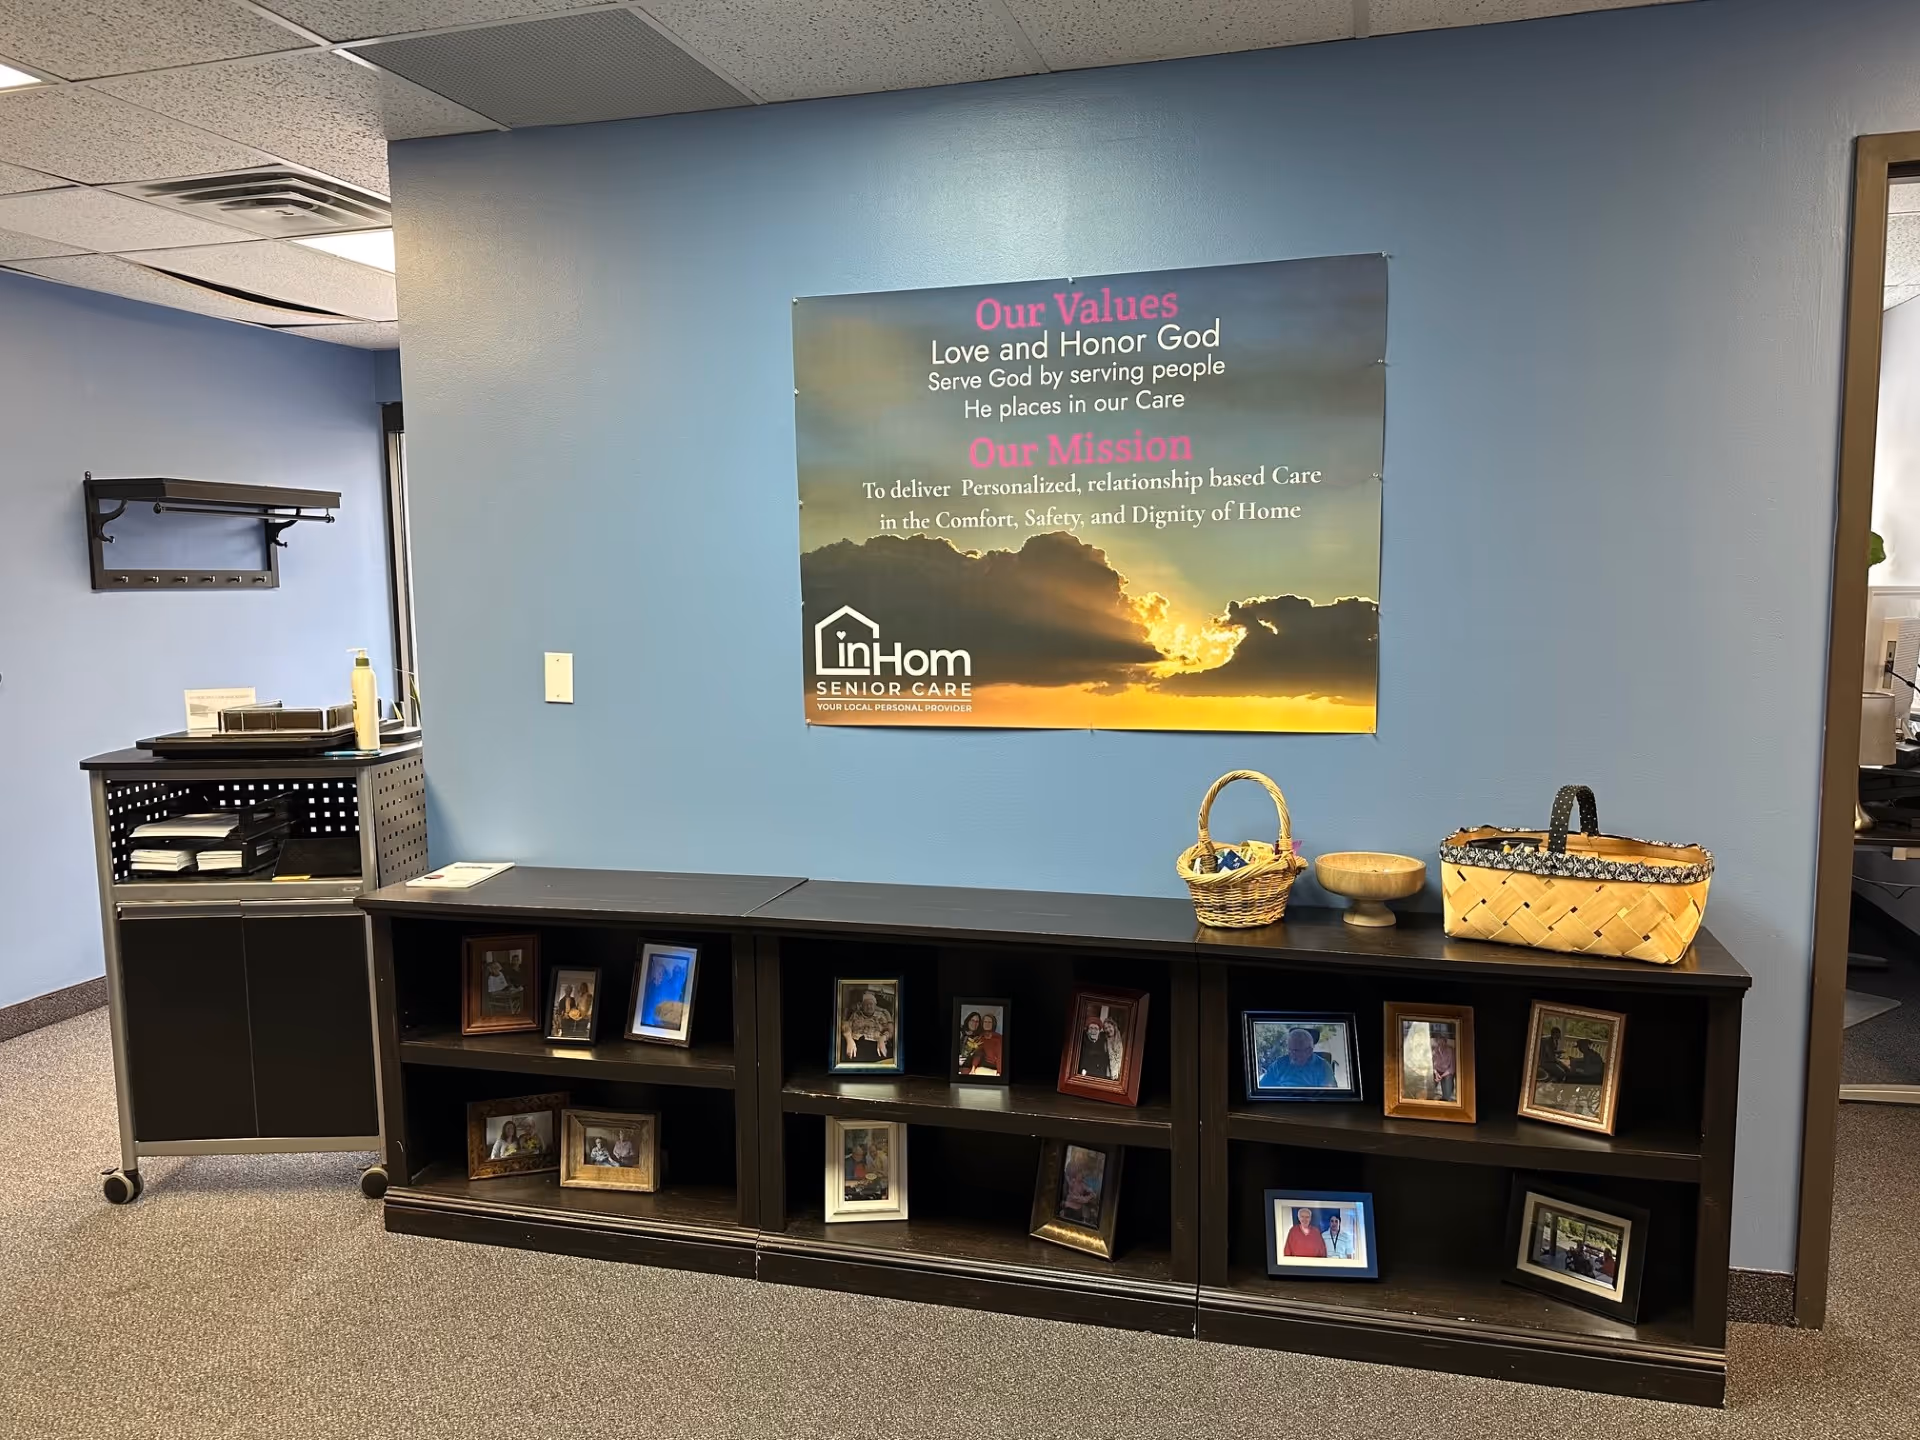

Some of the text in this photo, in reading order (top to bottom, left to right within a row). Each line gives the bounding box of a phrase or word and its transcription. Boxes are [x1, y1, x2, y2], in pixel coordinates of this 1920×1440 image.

[976, 288, 1178, 330] Our Values
[932, 317, 1220, 365] Love and Honor God
[928, 354, 1225, 391] Serve God by serving people
[965, 390, 1185, 422] He places in our Care
[970, 429, 1193, 468] Our Mission
[863, 466, 1321, 499] To deliver Personalized, relationship based Care
[880, 500, 1301, 531] in the Comfort, Safety, and Dignity of Home
[836, 631, 971, 676] inHom
[817, 681, 972, 696] SENIOR CARE
[817, 703, 842, 711] YOUR
[875, 704, 923, 712] PERSONAL
[925, 704, 972, 712] PROVIDER
